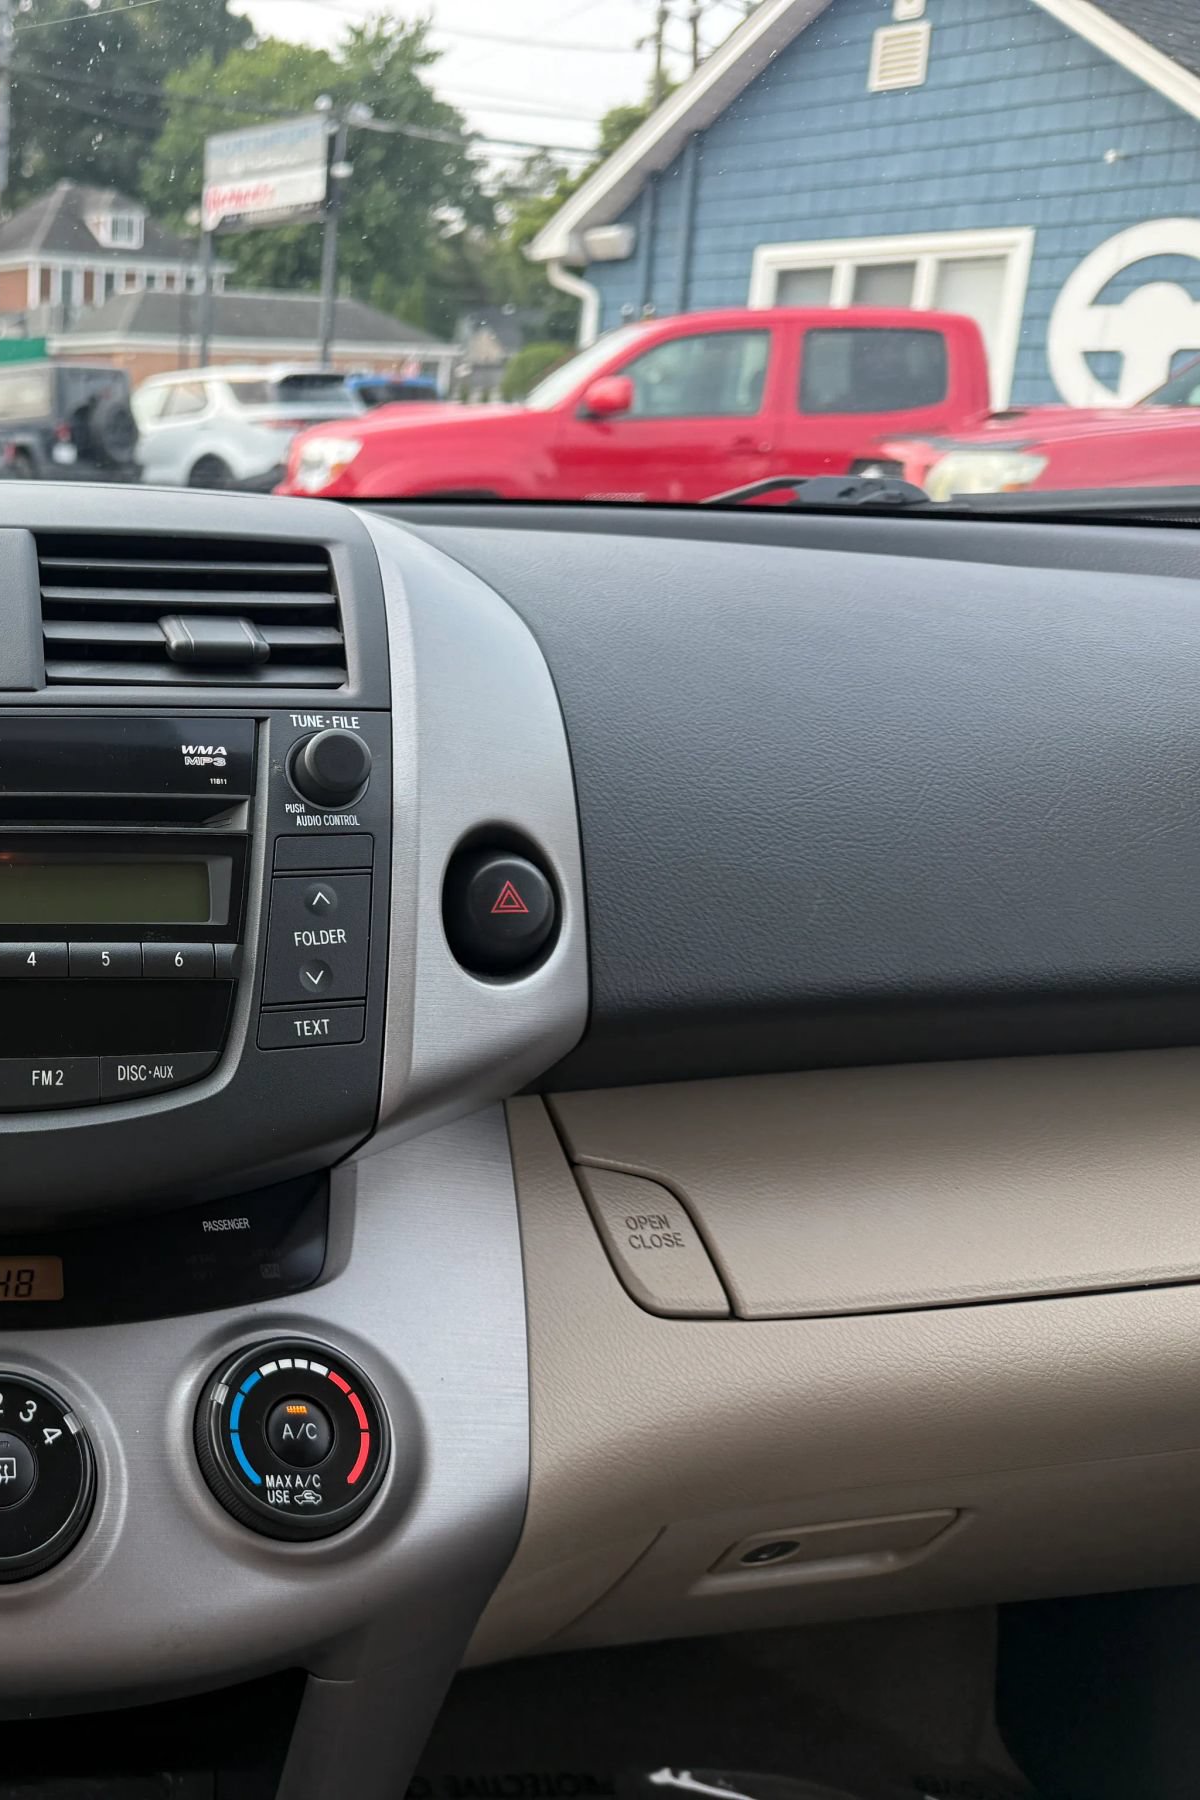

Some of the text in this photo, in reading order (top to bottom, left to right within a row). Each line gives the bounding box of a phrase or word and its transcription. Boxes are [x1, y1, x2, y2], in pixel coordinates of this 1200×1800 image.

[181, 745, 227, 755] WMA
[184, 756, 226, 767] MP3
[285, 803, 305, 814] PUSH
[296, 815, 360, 826] AUDIO CONTROL
[294, 929, 346, 946] FOLDER
[27, 952, 37, 967] 4
[101, 952, 110, 967] 5
[174, 952, 183, 967] 6
[294, 1018, 330, 1036] TEXT
[202, 1217, 250, 1232] PASSENGER
[625, 1214, 670, 1230] OPEN
[628, 1232, 685, 1249] CLOSE
[19, 1400, 37, 1422] 3
[42, 1427, 62, 1444] 4
[282, 1423, 317, 1440] A/C
[265, 1474, 320, 1488] MAX A/C
[267, 1490, 290, 1503] USE
